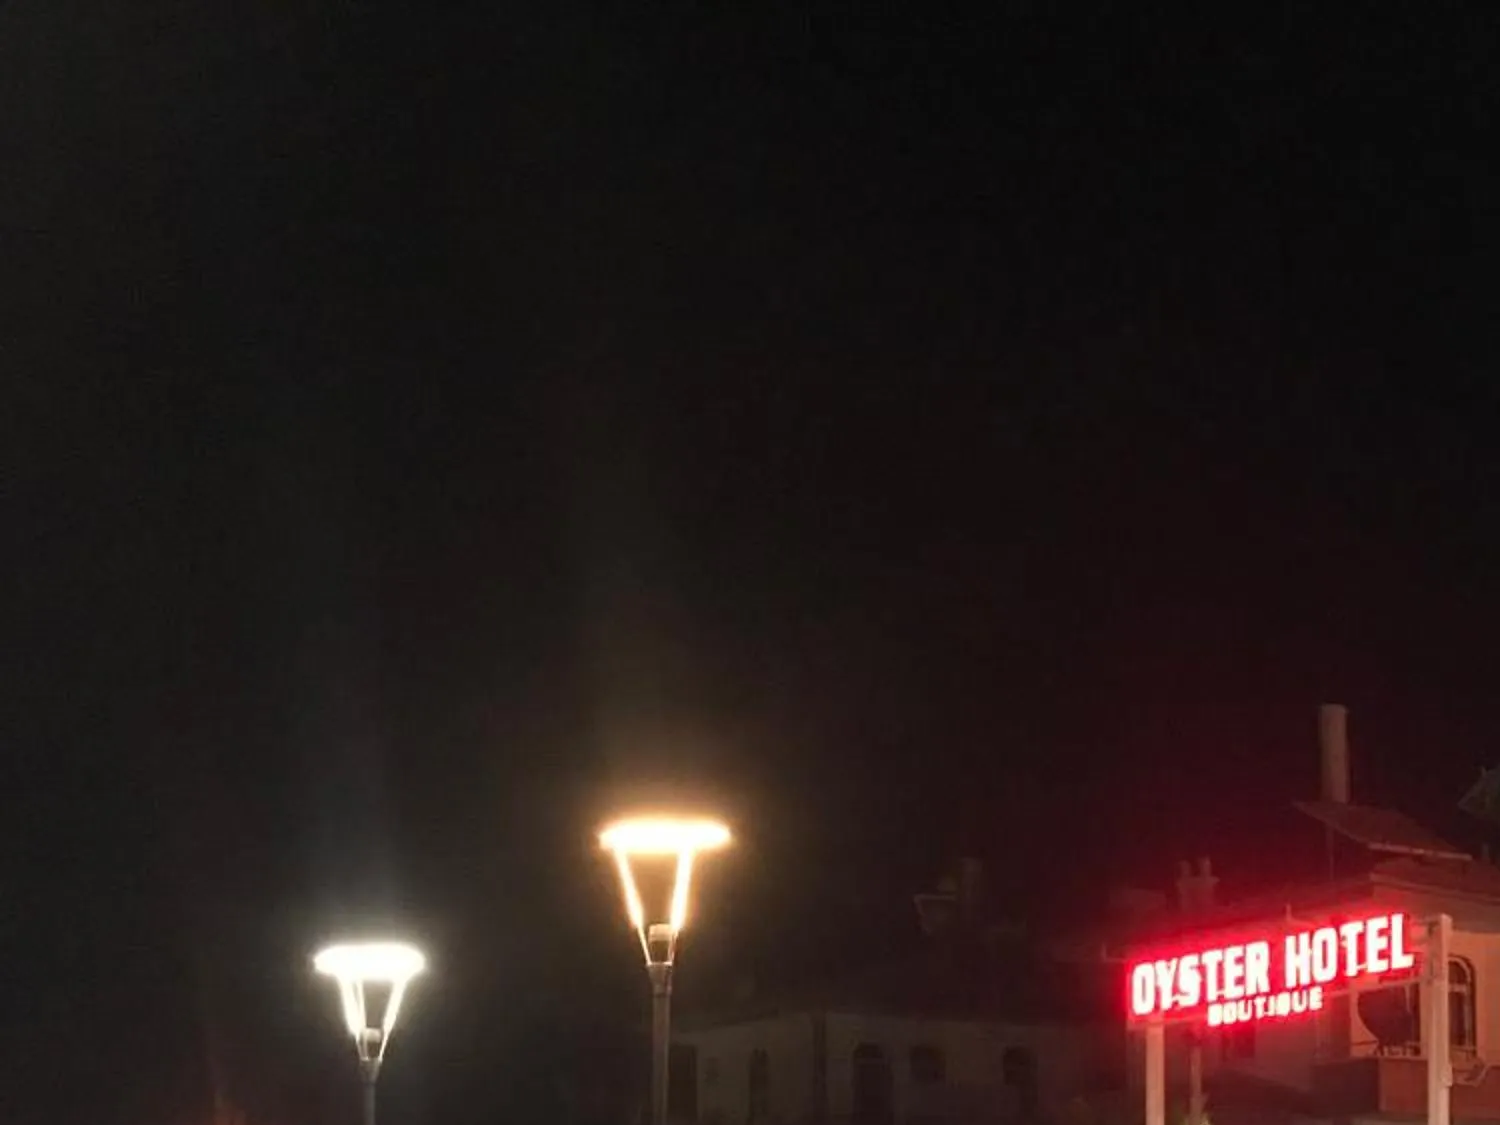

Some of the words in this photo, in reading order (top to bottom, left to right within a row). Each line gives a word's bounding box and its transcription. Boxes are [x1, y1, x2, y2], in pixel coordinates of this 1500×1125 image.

[1131, 941, 1271, 1016] OYSTER
[1284, 913, 1415, 989] HOTEL
[1206, 985, 1323, 1027] BOUTIQUE
